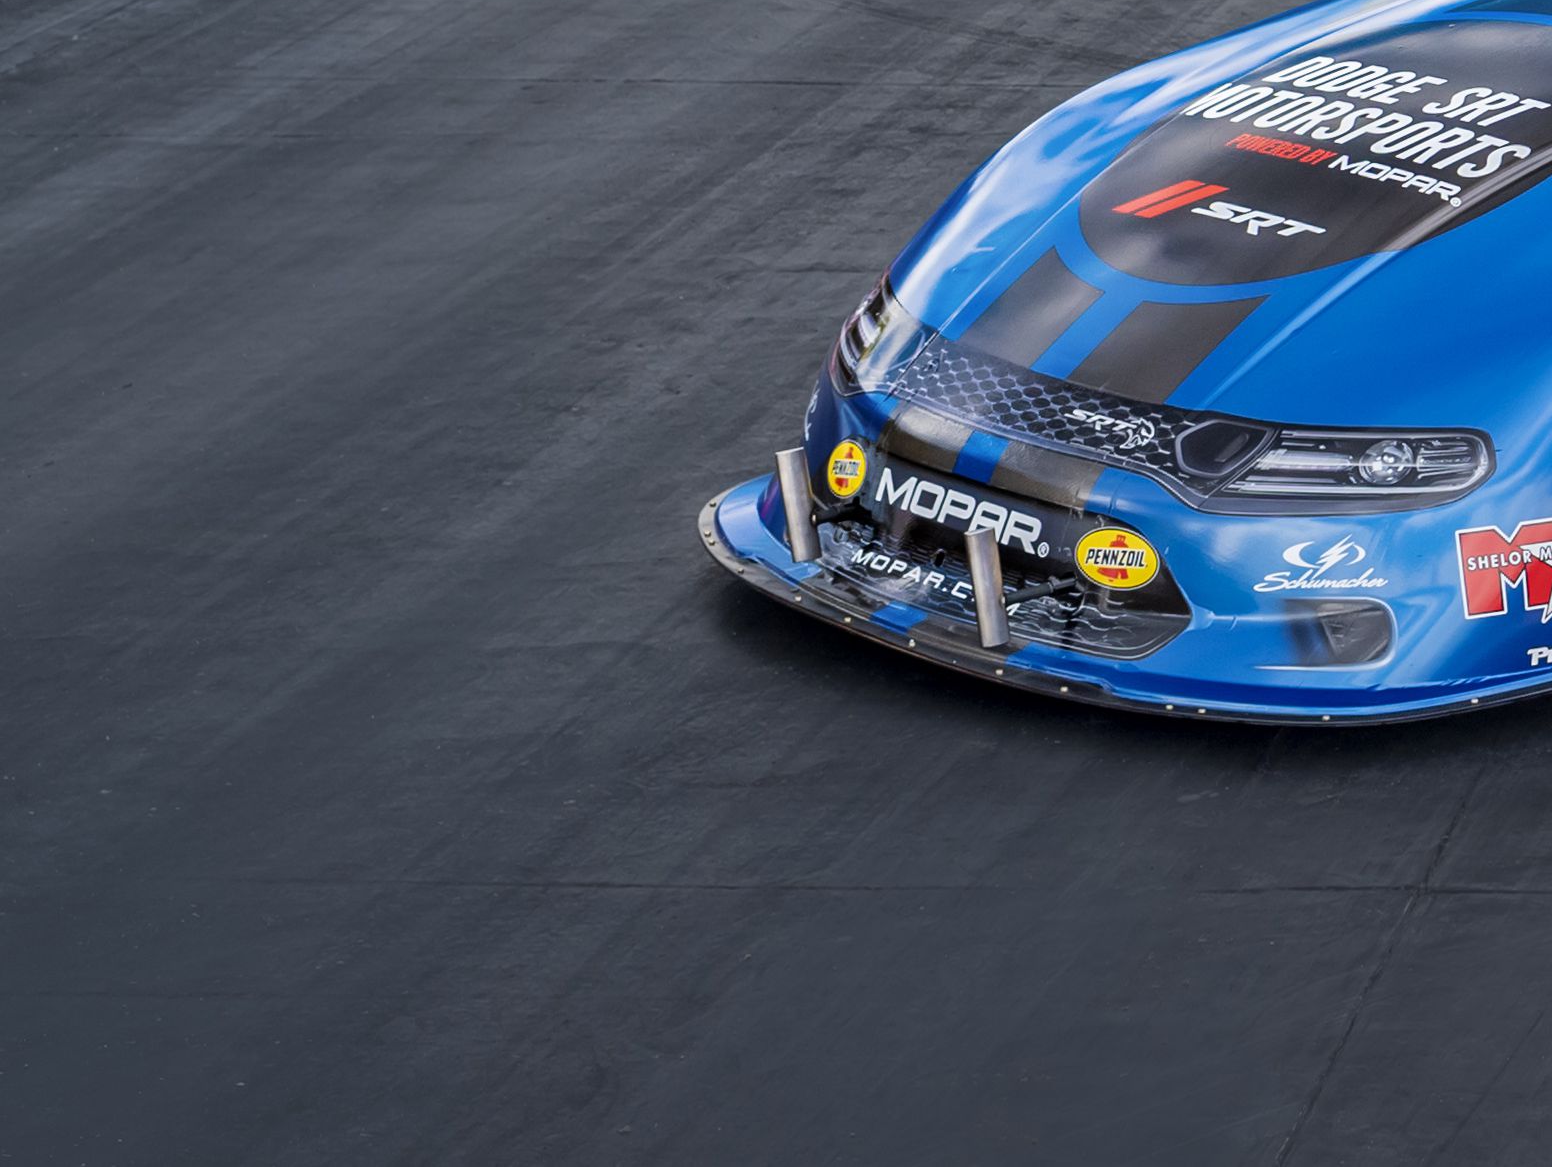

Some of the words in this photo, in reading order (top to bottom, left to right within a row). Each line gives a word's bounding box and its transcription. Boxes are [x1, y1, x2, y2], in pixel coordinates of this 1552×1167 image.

[1261, 55, 1447, 104] DODGE
[1423, 86, 1552, 129] SRT
[1180, 82, 1532, 181] MOTORSPORTS
[1225, 133, 1309, 162] POWERED
[1307, 149, 1337, 168] BY
[1328, 154, 1462, 204] MOPAR
[1190, 200, 1327, 236] SRT
[1063, 407, 1138, 434] SRT
[873, 466, 1043, 557] MOPAR
[850, 548, 1021, 617] MOPAR.C
[1083, 547, 1147, 568] PENNZOIL
[1252, 570, 1389, 594] Schumacher
[1466, 547, 1533, 572] SHELOR
